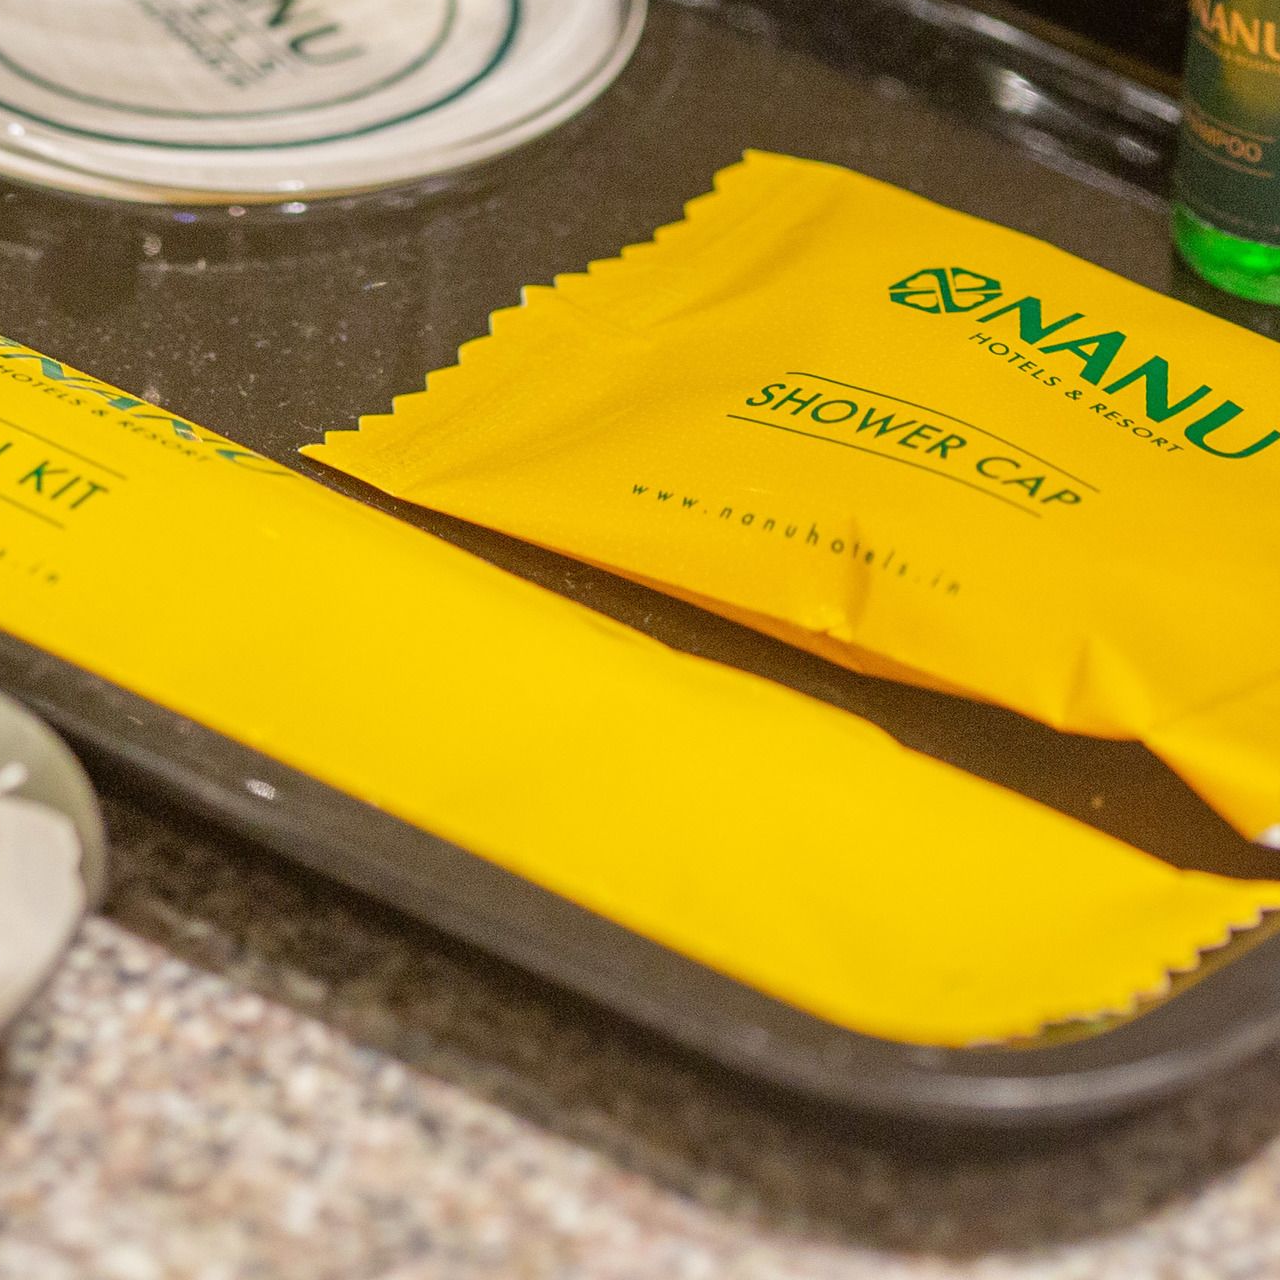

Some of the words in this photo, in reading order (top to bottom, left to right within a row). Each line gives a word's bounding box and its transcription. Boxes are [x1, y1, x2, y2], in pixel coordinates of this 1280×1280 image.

[91, 408, 110, 417] &
[746, 383, 967, 459] SHOWER
[975, 456, 1082, 507] CAP
[969, 332, 1061, 387] HOTELS
[1064, 389, 1083, 401] &
[1089, 403, 1184, 453] RESORT
[18, 461, 110, 510] KIT
[632, 484, 960, 595] www.nanuhotels.in
